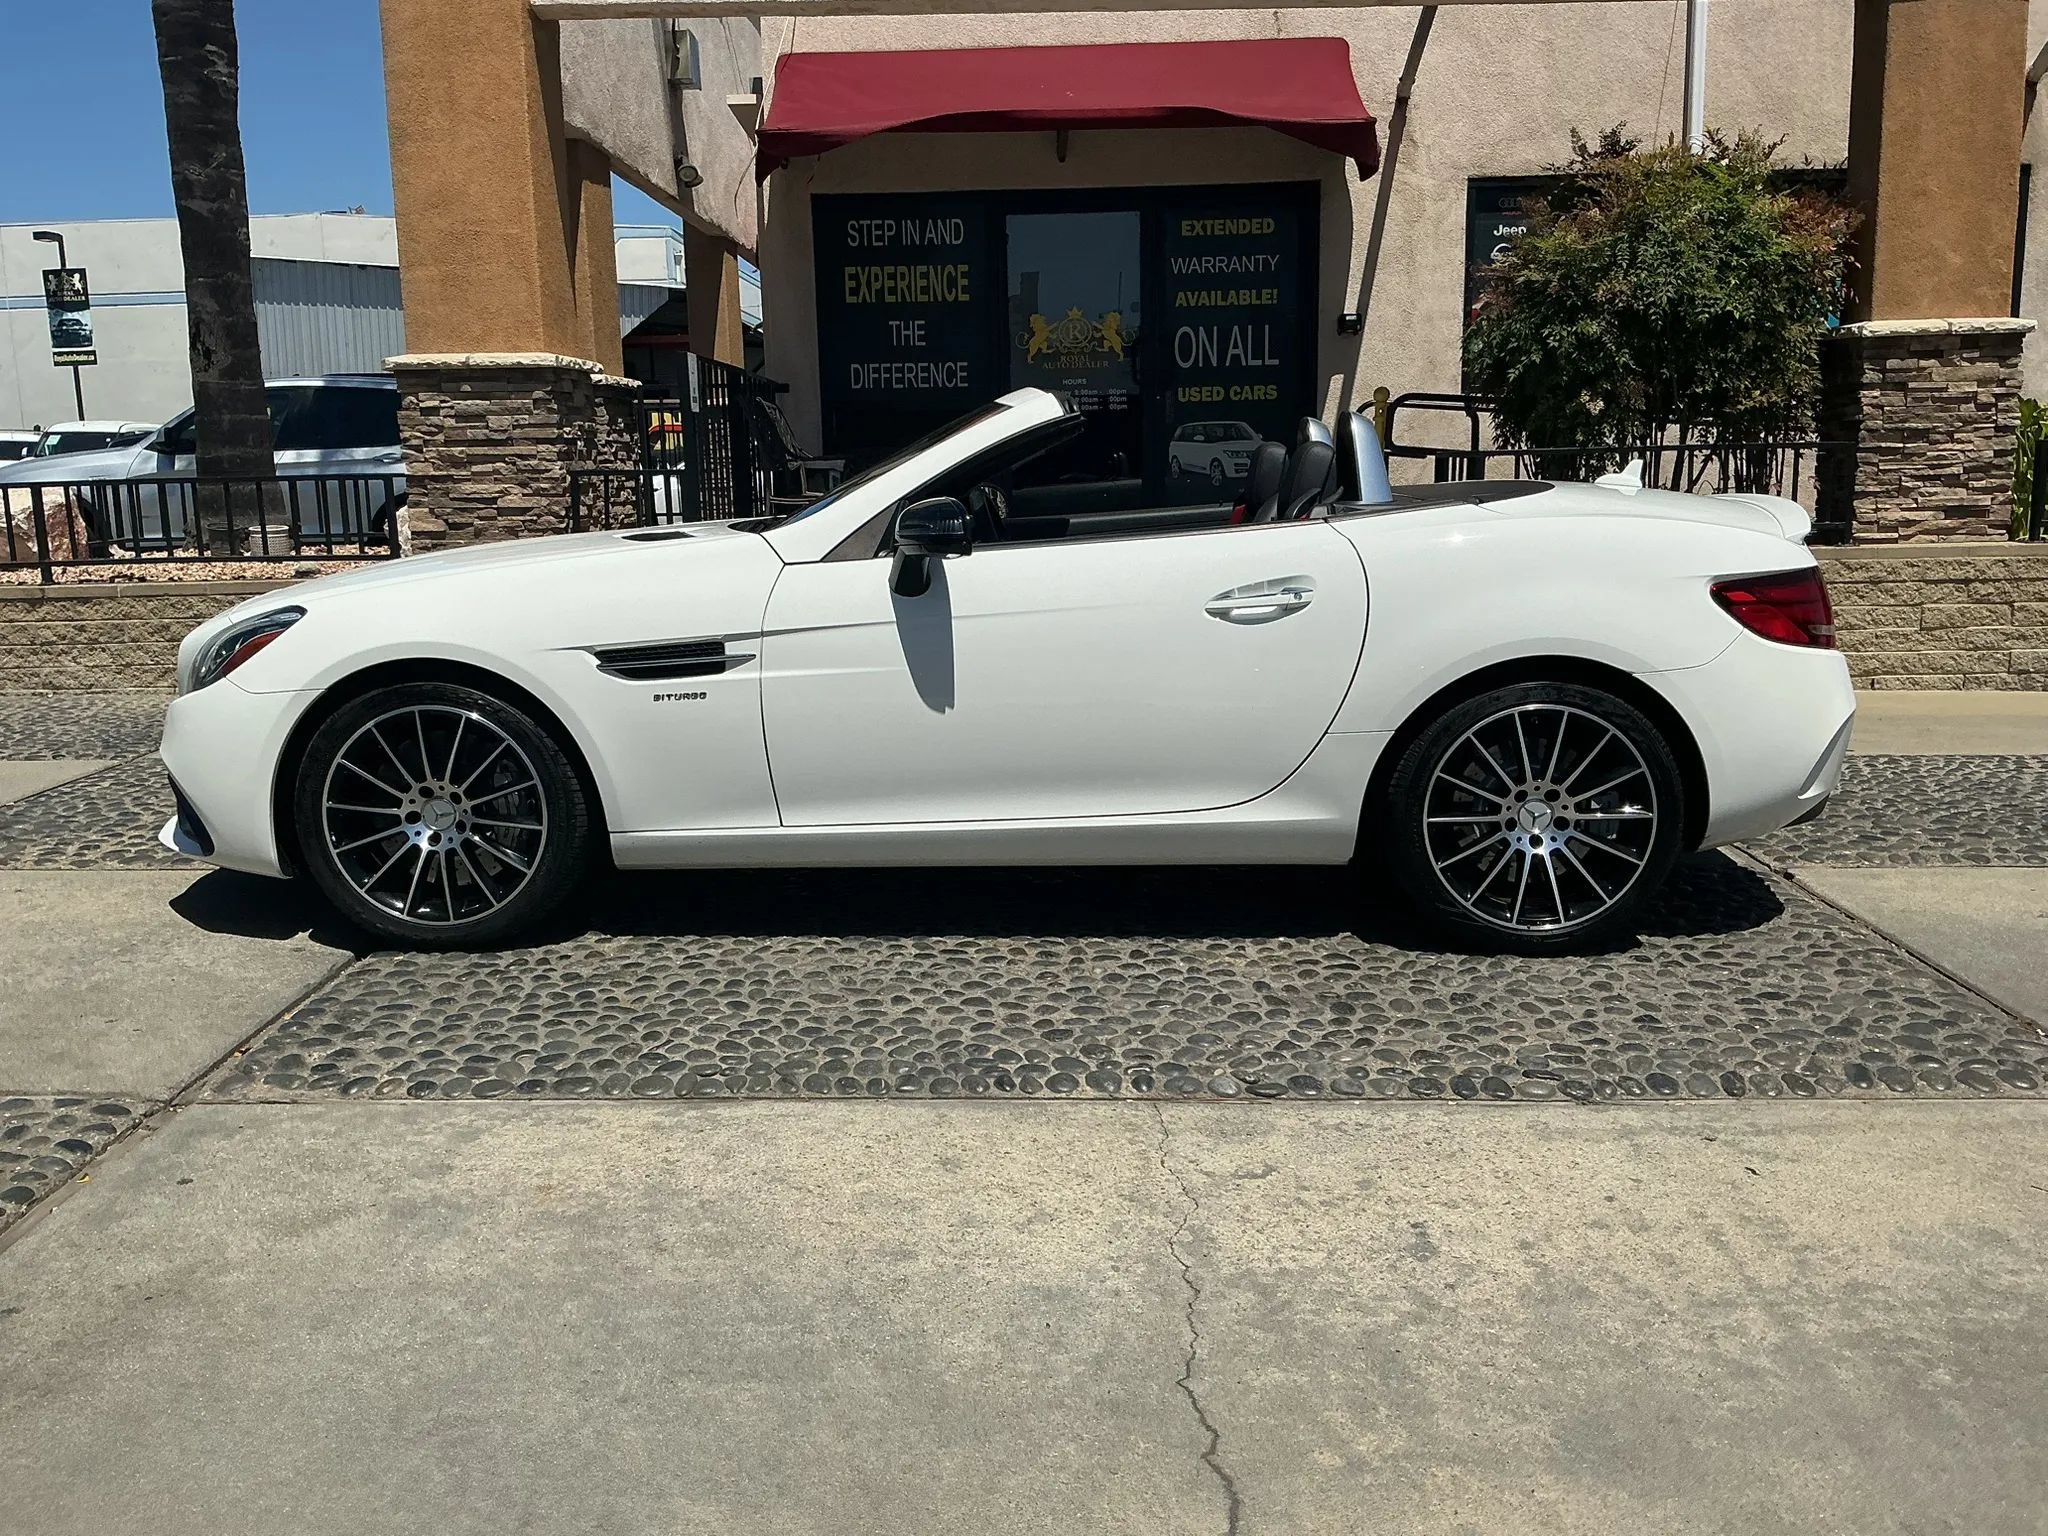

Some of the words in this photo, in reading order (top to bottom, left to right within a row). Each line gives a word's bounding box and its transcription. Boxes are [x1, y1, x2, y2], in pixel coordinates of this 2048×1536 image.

[847, 219, 896, 247] STEP
[902, 219, 920, 246] IN
[924, 218, 964, 245] AND
[1181, 218, 1275, 236] EXTENDED
[1170, 254, 1280, 275] WARRANTY
[844, 264, 970, 304] EXPERIENCE
[1175, 288, 1278, 307] AVAILABLE!
[888, 320, 926, 347] THE
[1174, 325, 1217, 369] ON
[1225, 324, 1280, 367] ALL
[850, 361, 969, 389] DIFFERENCE
[1177, 386, 1225, 402] USED
[1229, 384, 1278, 401] CARS
[653, 691, 707, 702] BITURBO
